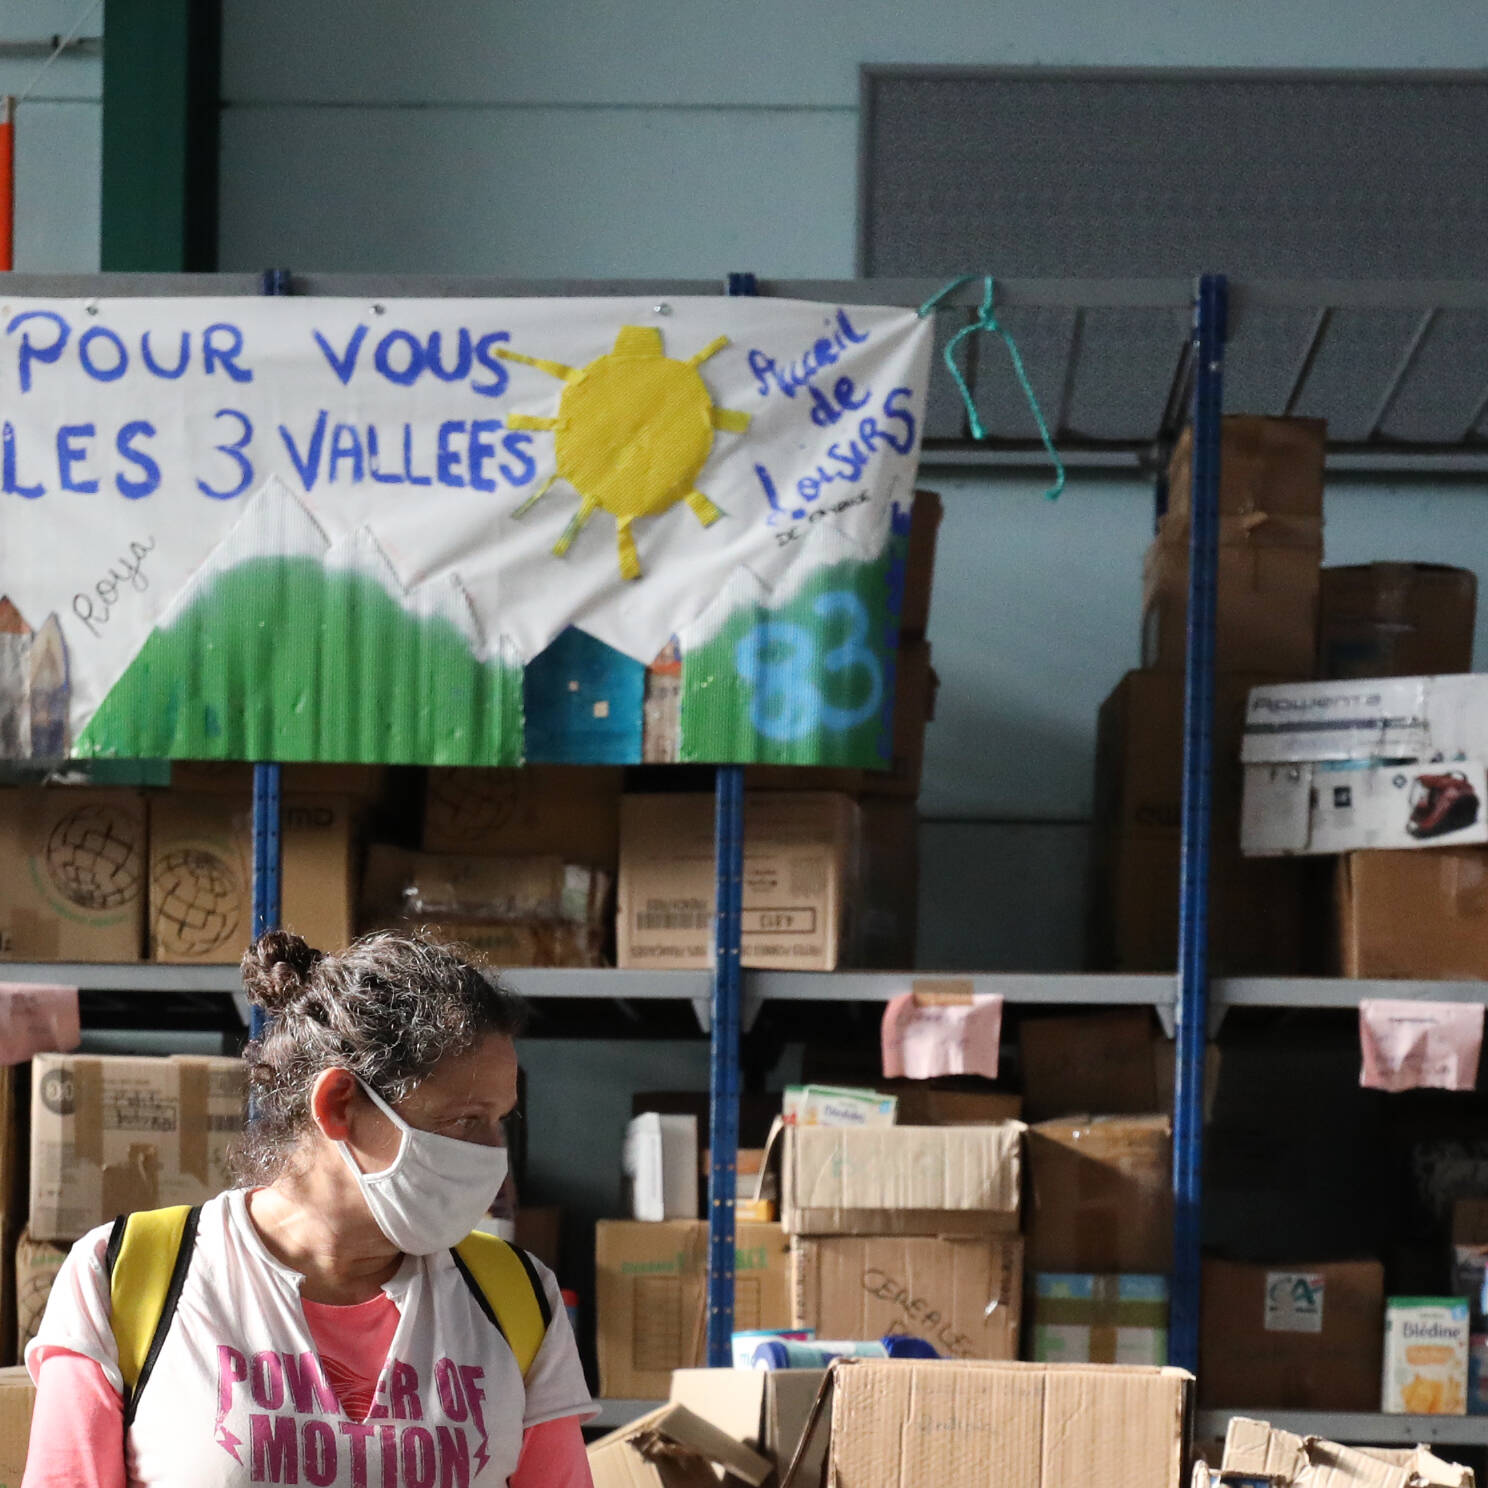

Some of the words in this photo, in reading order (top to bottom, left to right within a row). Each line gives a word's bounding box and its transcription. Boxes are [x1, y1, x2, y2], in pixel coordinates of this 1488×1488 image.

[5, 311, 252, 392] POUR
[314, 323, 512, 397] VOUS
[809, 376, 873, 427] de
[2, 420, 162, 499] LES
[196, 409, 255, 499] 3
[279, 409, 536, 493] VALLEES
[72, 535, 155, 636] Roya
[1403, 1319, 1461, 1340] Blédine
[216, 1345, 424, 1422] POWER
[435, 1357, 487, 1432] OF
